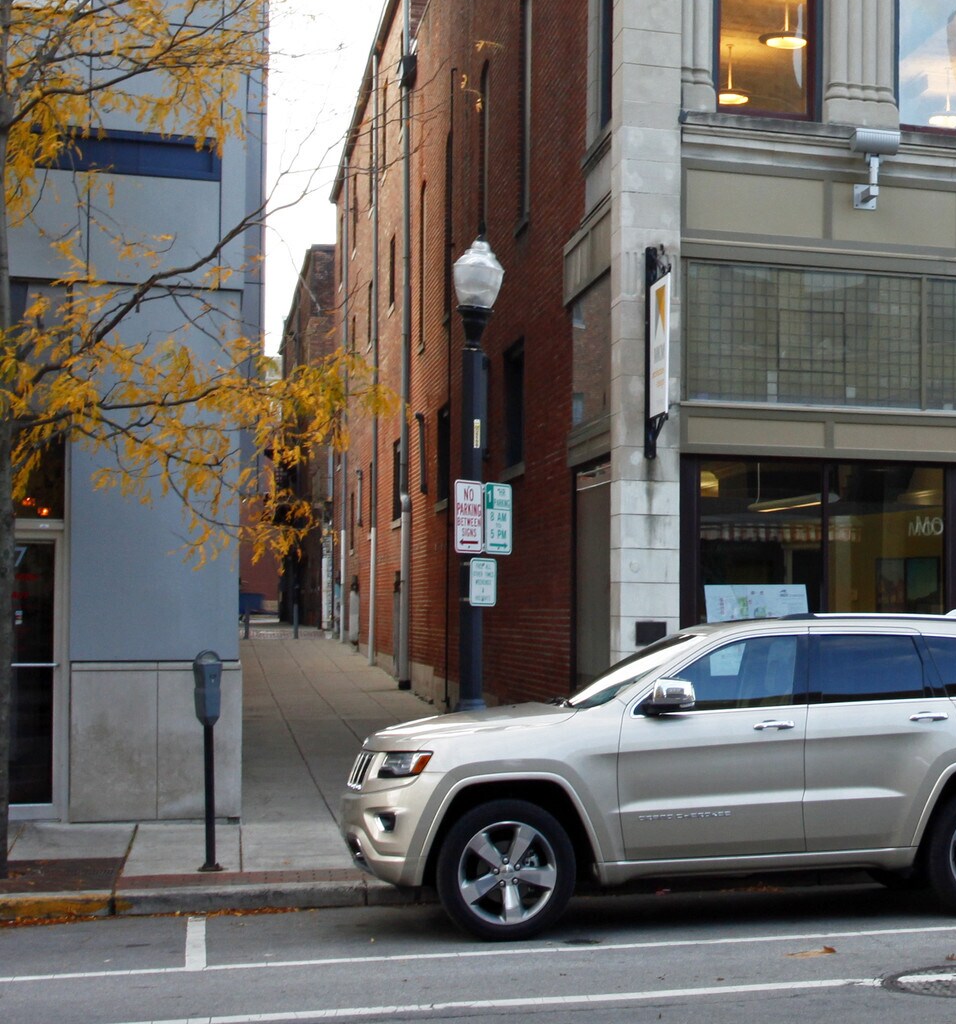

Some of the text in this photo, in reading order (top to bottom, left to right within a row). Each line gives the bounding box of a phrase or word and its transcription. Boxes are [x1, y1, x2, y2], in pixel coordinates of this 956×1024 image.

[463, 487, 475, 502] NO
[487, 490, 492, 503] 1
[494, 498, 511, 508] PARKING
[456, 502, 482, 517] PARKING
[490, 511, 507, 522] 8 AM
[456, 517, 481, 528] BETWEEN
[462, 528, 477, 538] SIGNS
[490, 528, 507, 539] 5 PM
